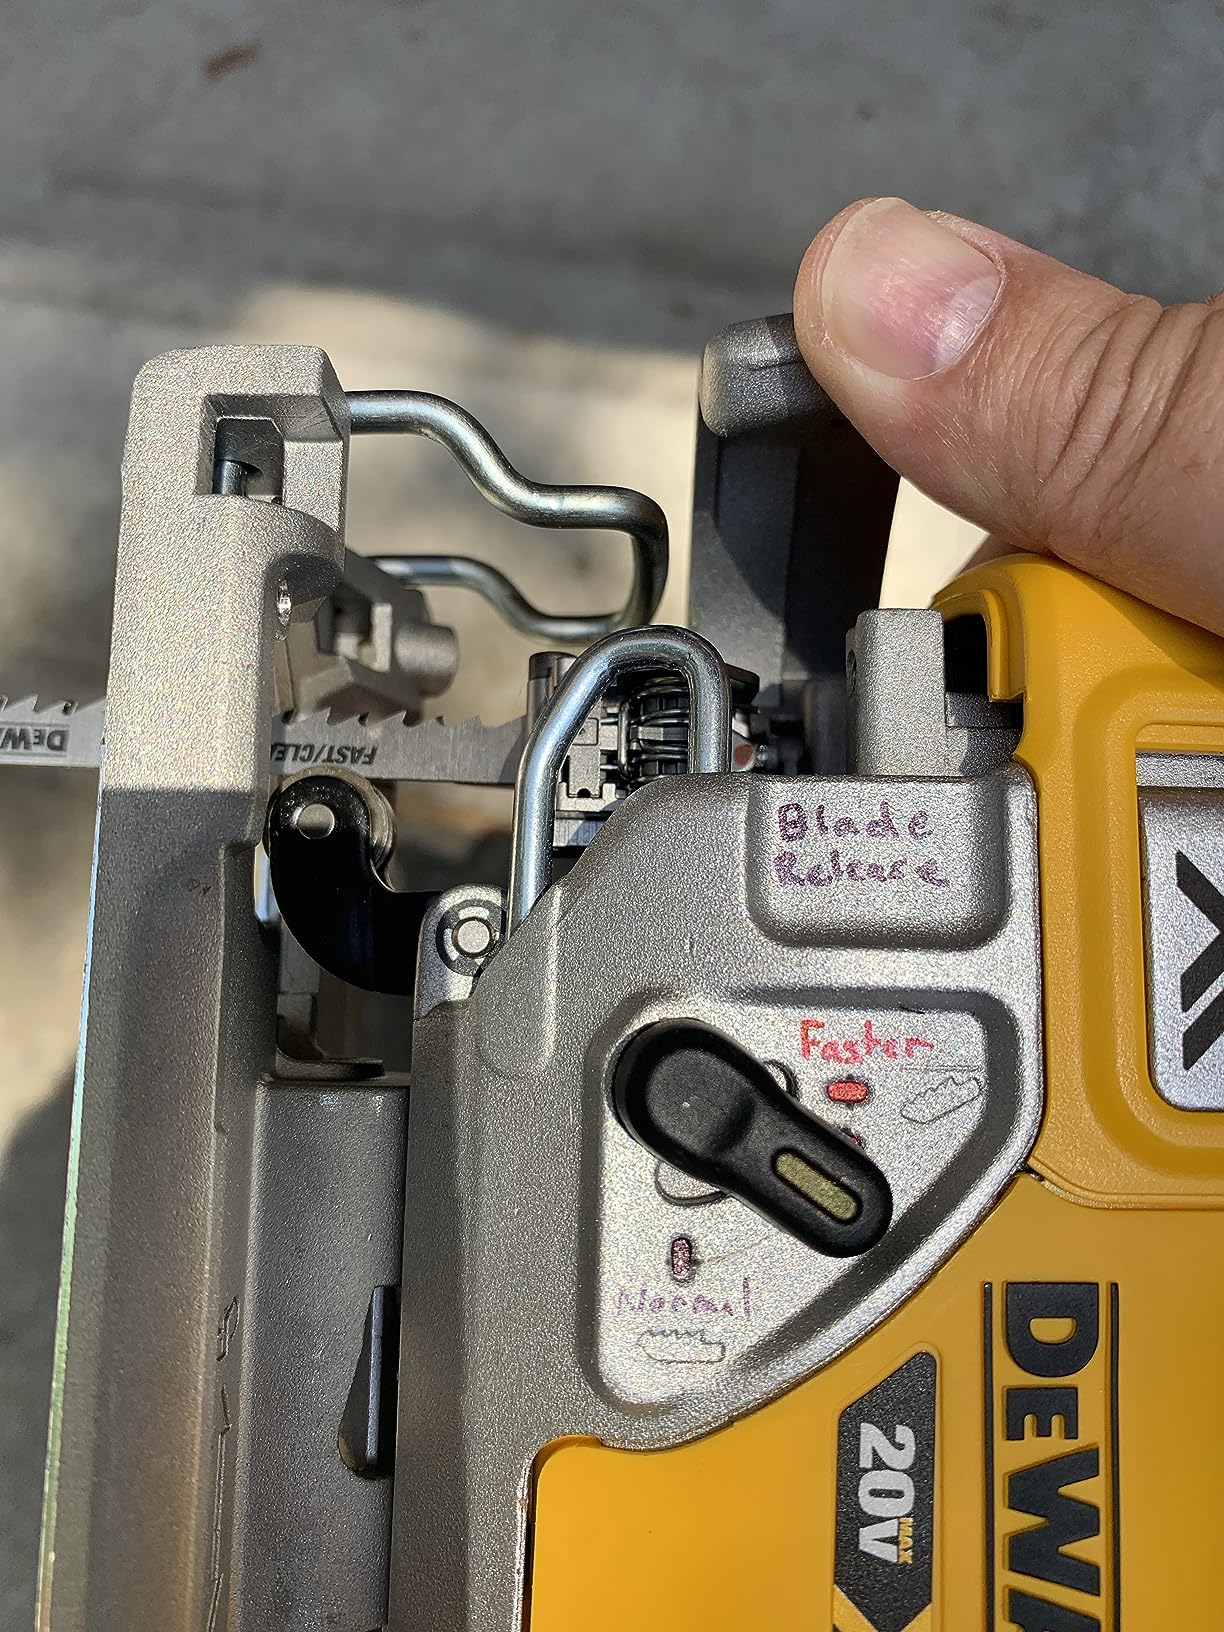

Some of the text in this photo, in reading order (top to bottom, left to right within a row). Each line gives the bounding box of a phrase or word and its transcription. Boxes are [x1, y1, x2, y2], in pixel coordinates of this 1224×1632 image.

[0, 728, 69, 752] DEW
[778, 801, 933, 842] Blade
[773, 850, 950, 887] Release
[800, 1019, 936, 1065] Faster
[858, 1422, 916, 1565] 20V MAX
